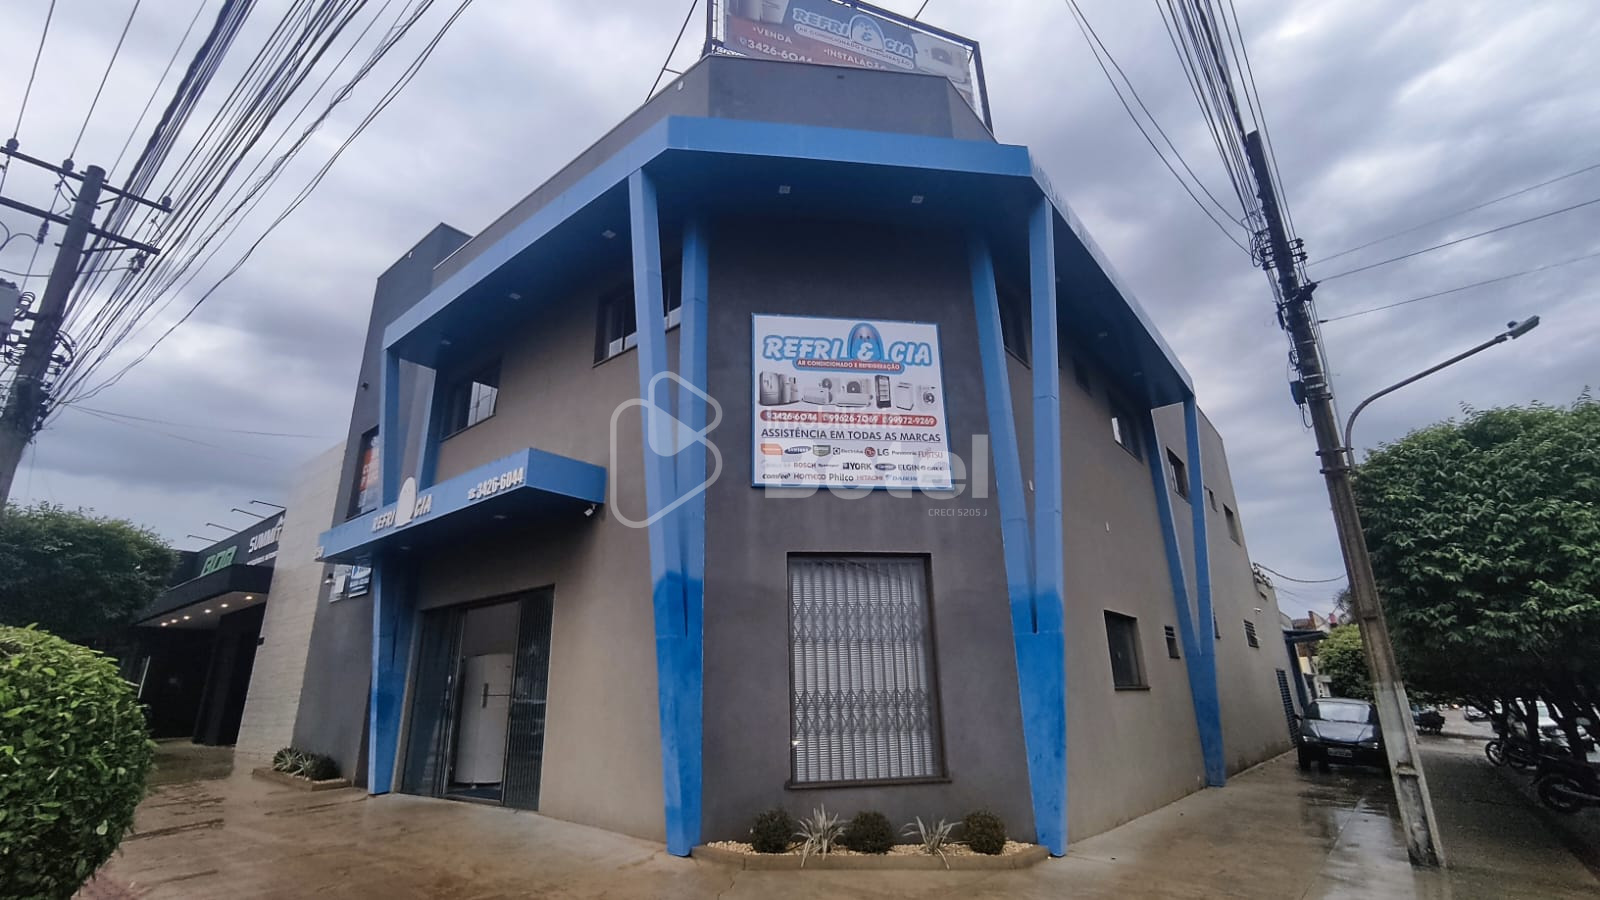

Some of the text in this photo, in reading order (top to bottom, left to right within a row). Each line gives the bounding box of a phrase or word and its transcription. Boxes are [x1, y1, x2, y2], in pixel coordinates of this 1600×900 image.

[757, 26, 793, 44] VENDA
[793, 8, 849, 38] REFRI
[885, 38, 914, 59] CIA
[763, 335, 933, 366] REFRI & CIA
[807, 360, 853, 368] CONDICIONADO
[772, 411, 817, 421] 3426-6044
[830, 430, 845, 439] EM
[849, 431, 881, 440] TODAS
[884, 432, 897, 441] AS
[900, 433, 941, 442] MARCAS
[849, 462, 872, 470] YORK
[898, 464, 920, 472] ELGIN
[476, 466, 525, 499] 3426-6044
[829, 473, 854, 482] Philco
[371, 494, 433, 532] REFRI CIA
